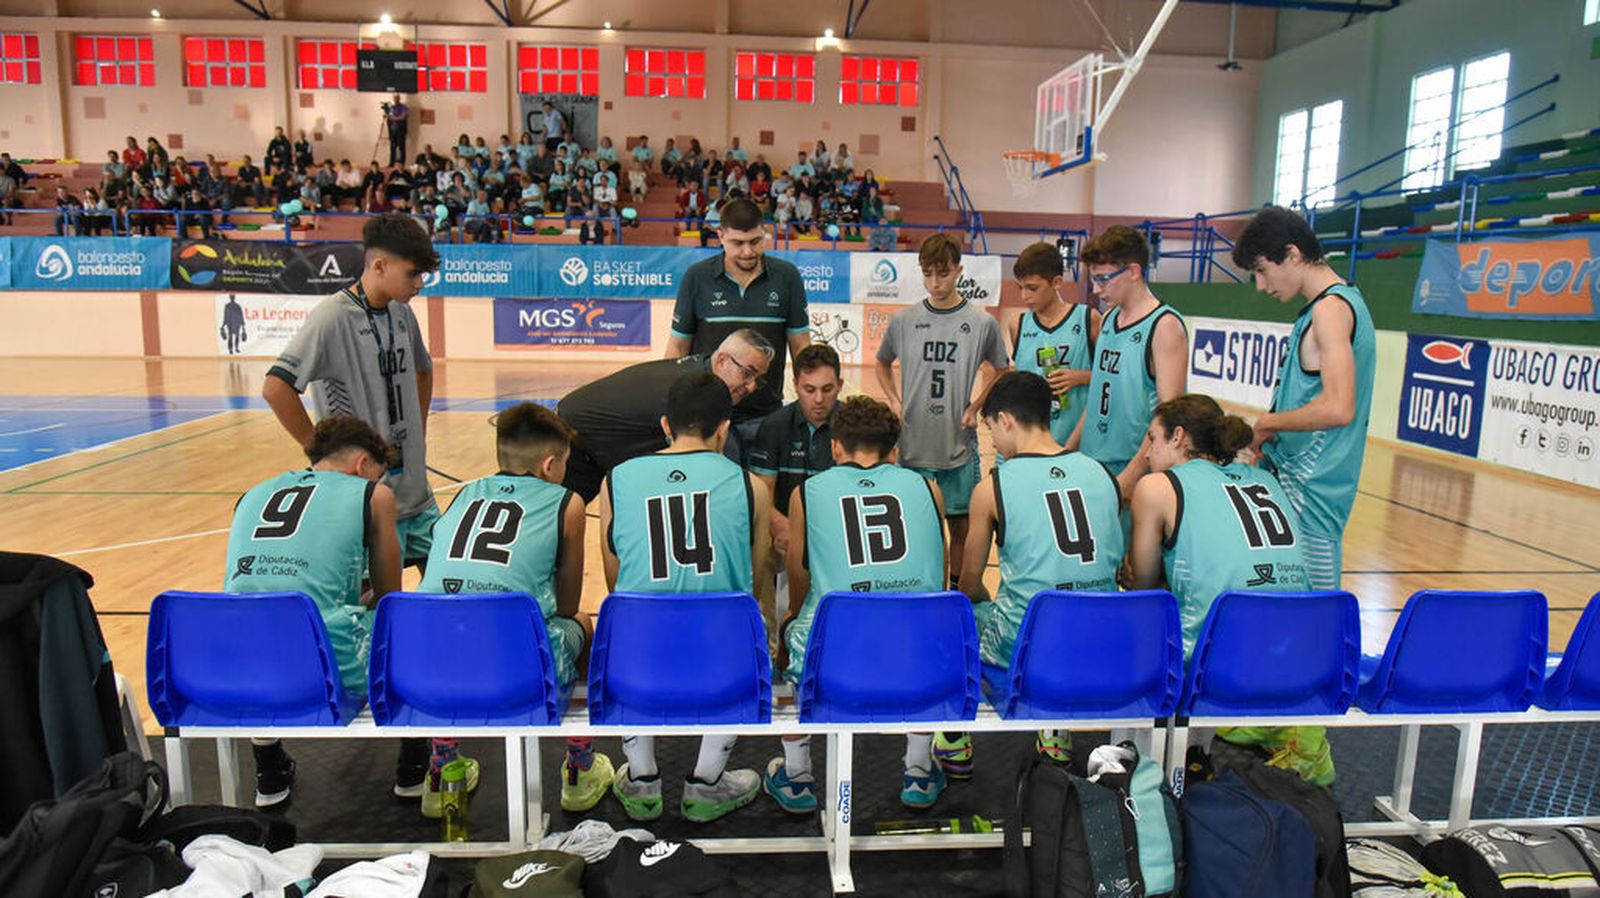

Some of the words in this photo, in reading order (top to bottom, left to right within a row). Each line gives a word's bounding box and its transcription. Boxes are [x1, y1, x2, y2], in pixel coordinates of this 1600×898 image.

[77, 249, 145, 264] baloncesto
[444, 257, 512, 271] baloncesto
[593, 260, 641, 273] BASKET
[592, 273, 673, 286] SOSTENIBLE
[244, 307, 259, 320] La
[519, 308, 576, 328] MGS
[923, 341, 959, 363] CDZ
[1493, 347, 1557, 387] UBAGO
[931, 369, 945, 399] 5
[1408, 385, 1472, 440] UBAGO
[1491, 392, 1599, 432] www.ubagogroup.
[251, 484, 319, 540] 9
[1044, 487, 1096, 565] 4
[1222, 482, 1296, 550] 15
[447, 498, 524, 566] 12
[646, 490, 714, 581] 14
[840, 494, 908, 569] 13
[256, 567, 268, 575] de
[271, 566, 298, 576] Cádiz
[842, 781, 850, 824] COADE
[511, 862, 547, 882] NIKE
